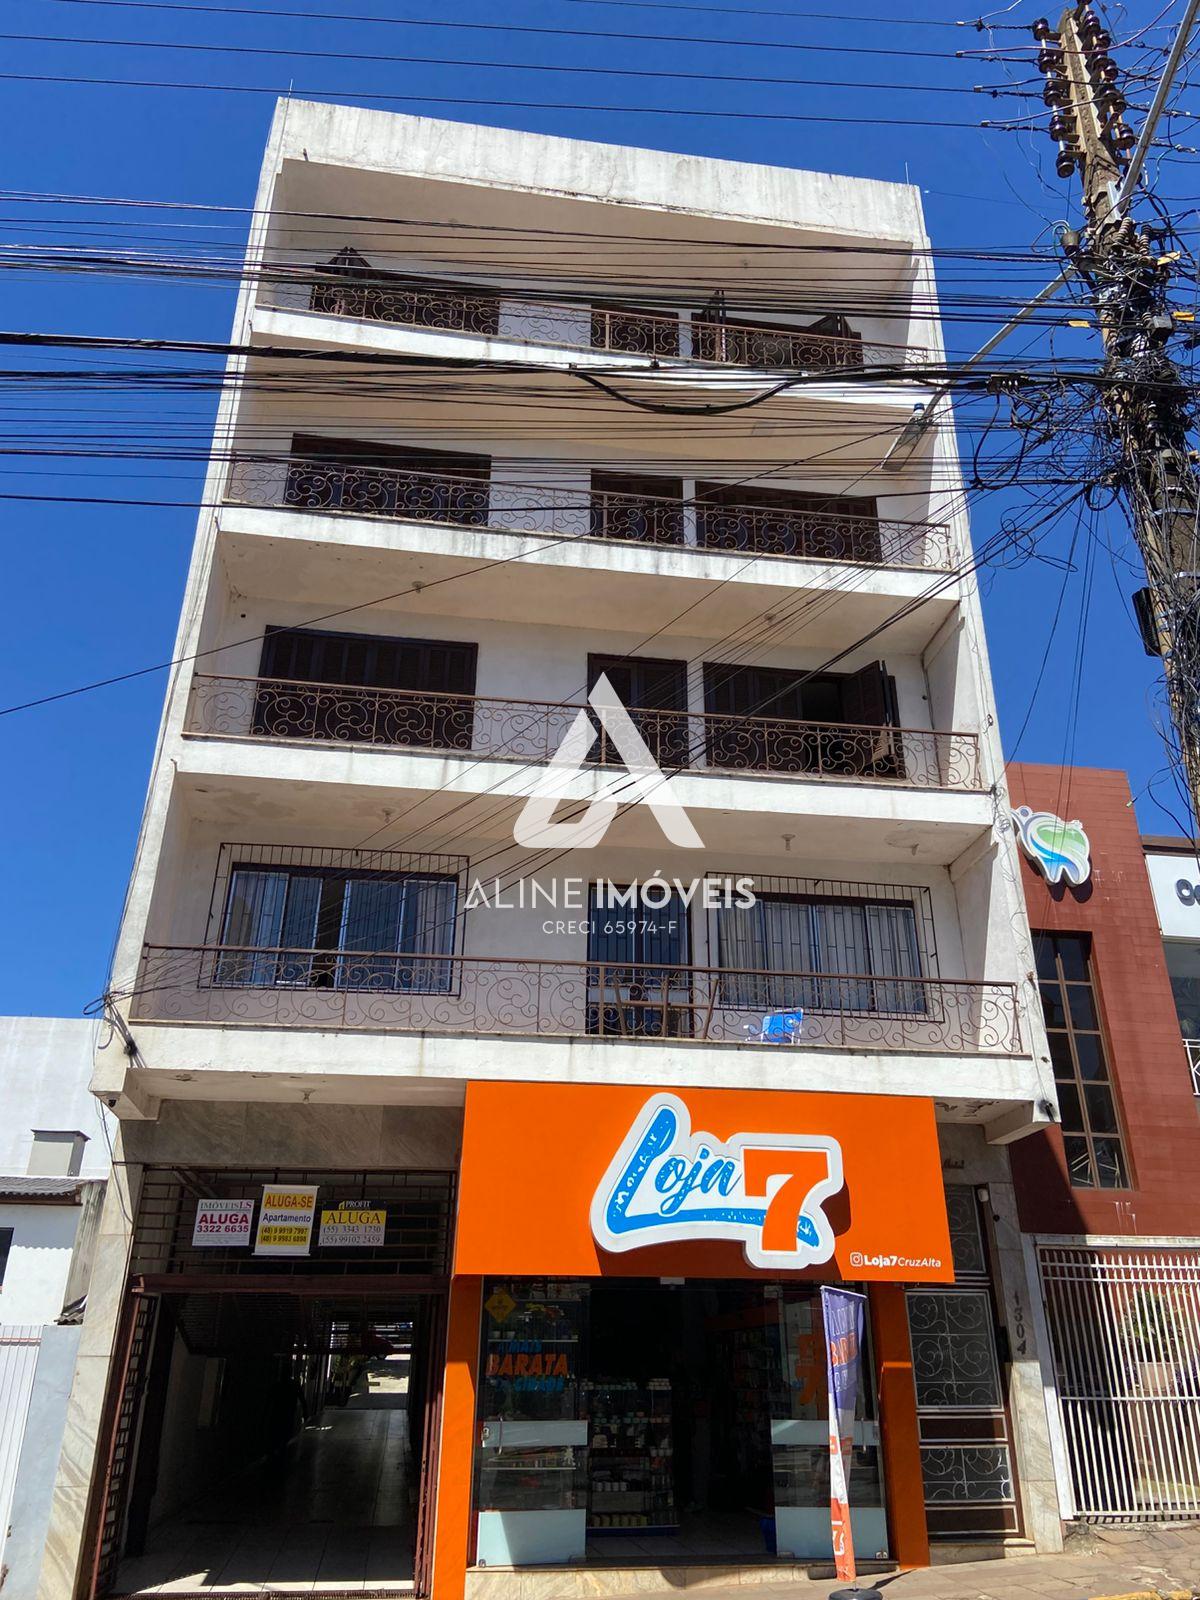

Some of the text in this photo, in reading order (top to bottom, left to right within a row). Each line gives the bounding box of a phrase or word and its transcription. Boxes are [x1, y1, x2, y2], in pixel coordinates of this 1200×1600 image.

[606, 1108, 829, 1252] Loja 7
[265, 1194, 313, 1209] ALUGA-SE
[345, 1200, 371, 1208] PROFIT
[199, 1213, 249, 1225] ALUGA
[262, 1212, 312, 1223] Apartamento
[326, 1211, 381, 1225] ALUGA
[196, 1224, 249, 1233] 3322 6635
[323, 1225, 338, 1234] (55)
[322, 1235, 338, 1245] (55)
[1014, 1290, 1027, 1355] 1304
[485, 1352, 569, 1377] BARATA
